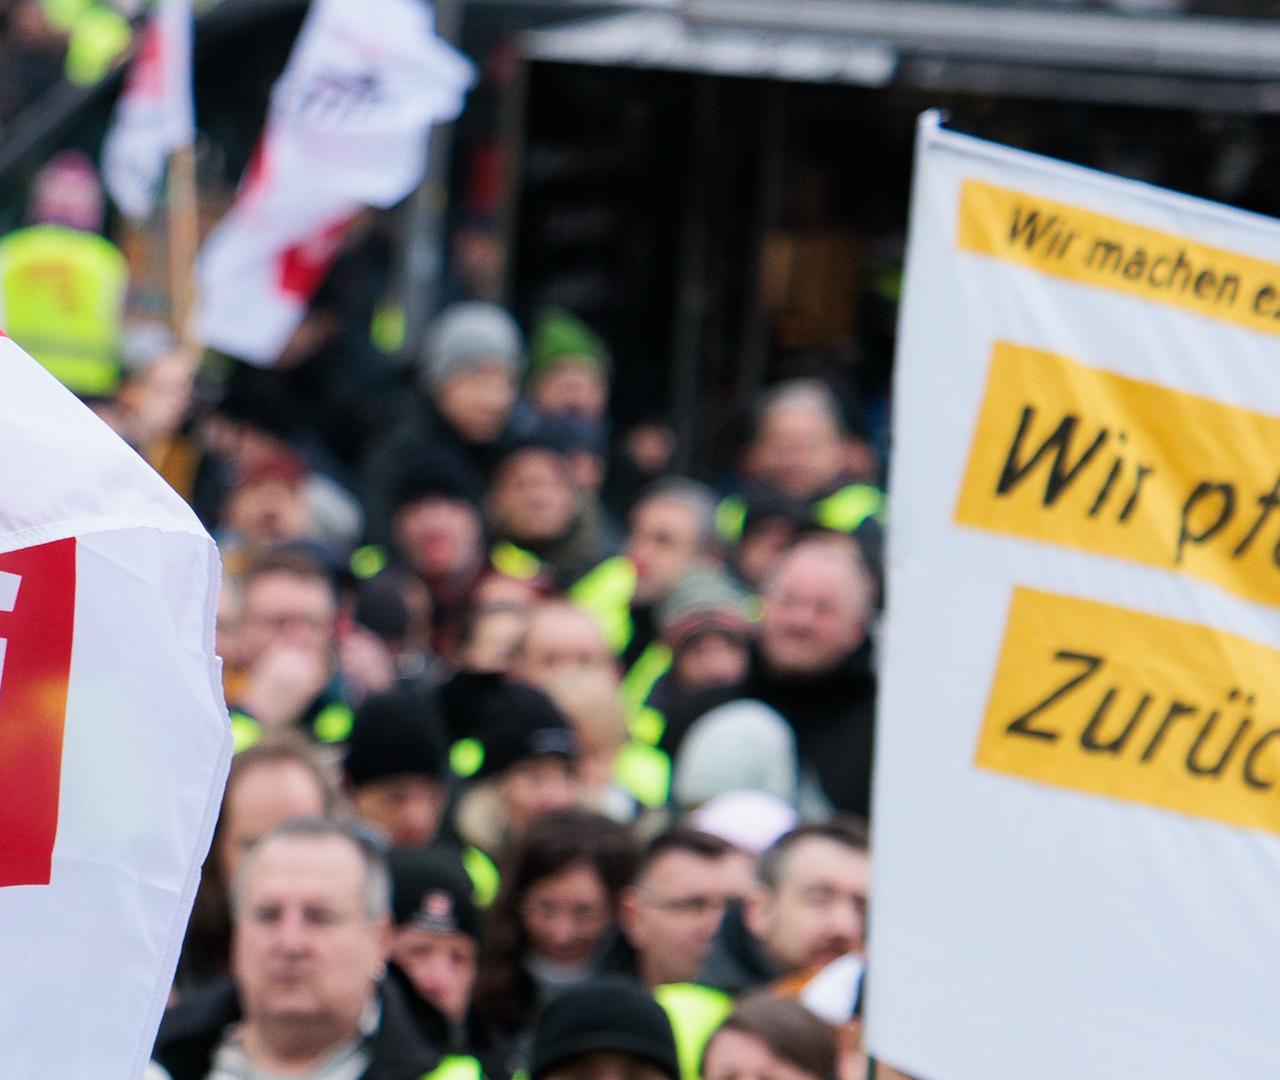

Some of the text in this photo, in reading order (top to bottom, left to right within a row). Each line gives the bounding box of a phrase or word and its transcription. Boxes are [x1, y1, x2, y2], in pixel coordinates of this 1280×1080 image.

[1008, 205, 1280, 321] Wir machen e
[995, 401, 1280, 569] Wir pf
[1005, 649, 1280, 792] Zurüc
